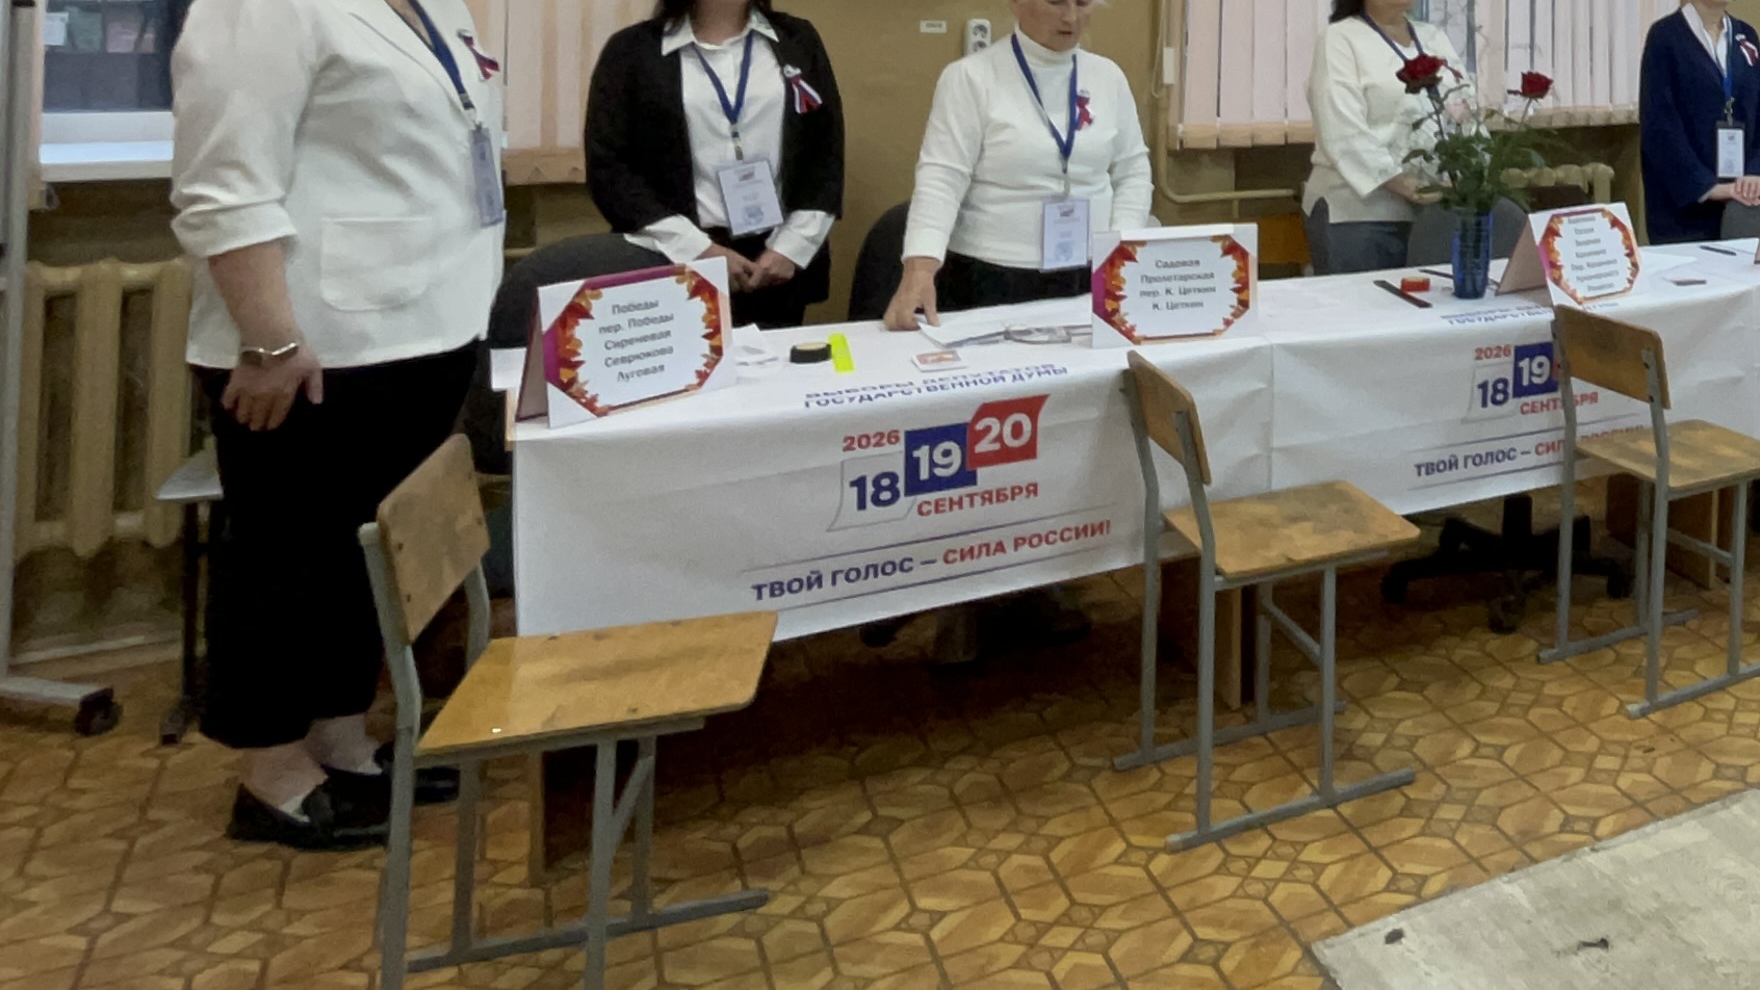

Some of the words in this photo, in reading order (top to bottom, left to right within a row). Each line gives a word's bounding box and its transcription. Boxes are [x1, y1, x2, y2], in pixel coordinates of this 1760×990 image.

[1155, 259, 1200, 269] Садовая
[1141, 272, 1215, 284] Пролетарская
[612, 300, 659, 315] Победы
[628, 313, 674, 329] Победы
[604, 330, 672, 351] Сиреневая
[604, 346, 674, 368] Севрюкова
[1475, 345, 1512, 361] 2026
[617, 364, 665, 382] Луговая
[1477, 377, 1510, 409] 18
[1518, 355, 1551, 387] 19
[1520, 391, 1599, 415] СЕНТБРЯ
[842, 429, 901, 452] 2026
[849, 470, 900, 511] 18
[912, 440, 963, 482] 19
[974, 412, 1033, 454] 20
[1414, 455, 1459, 477] ТВОЙ
[1464, 448, 1517, 469] ГОЛОС
[1534, 439, 1565, 456] СИЛ
[916, 482, 1039, 518] СЕНТЯБРЯ
[751, 570, 824, 602] ТВОЙ
[830, 556, 915, 587] ГОЛОС
[943, 540, 1007, 567] СИЛА
[1013, 519, 1111, 553] РОССИИ!
